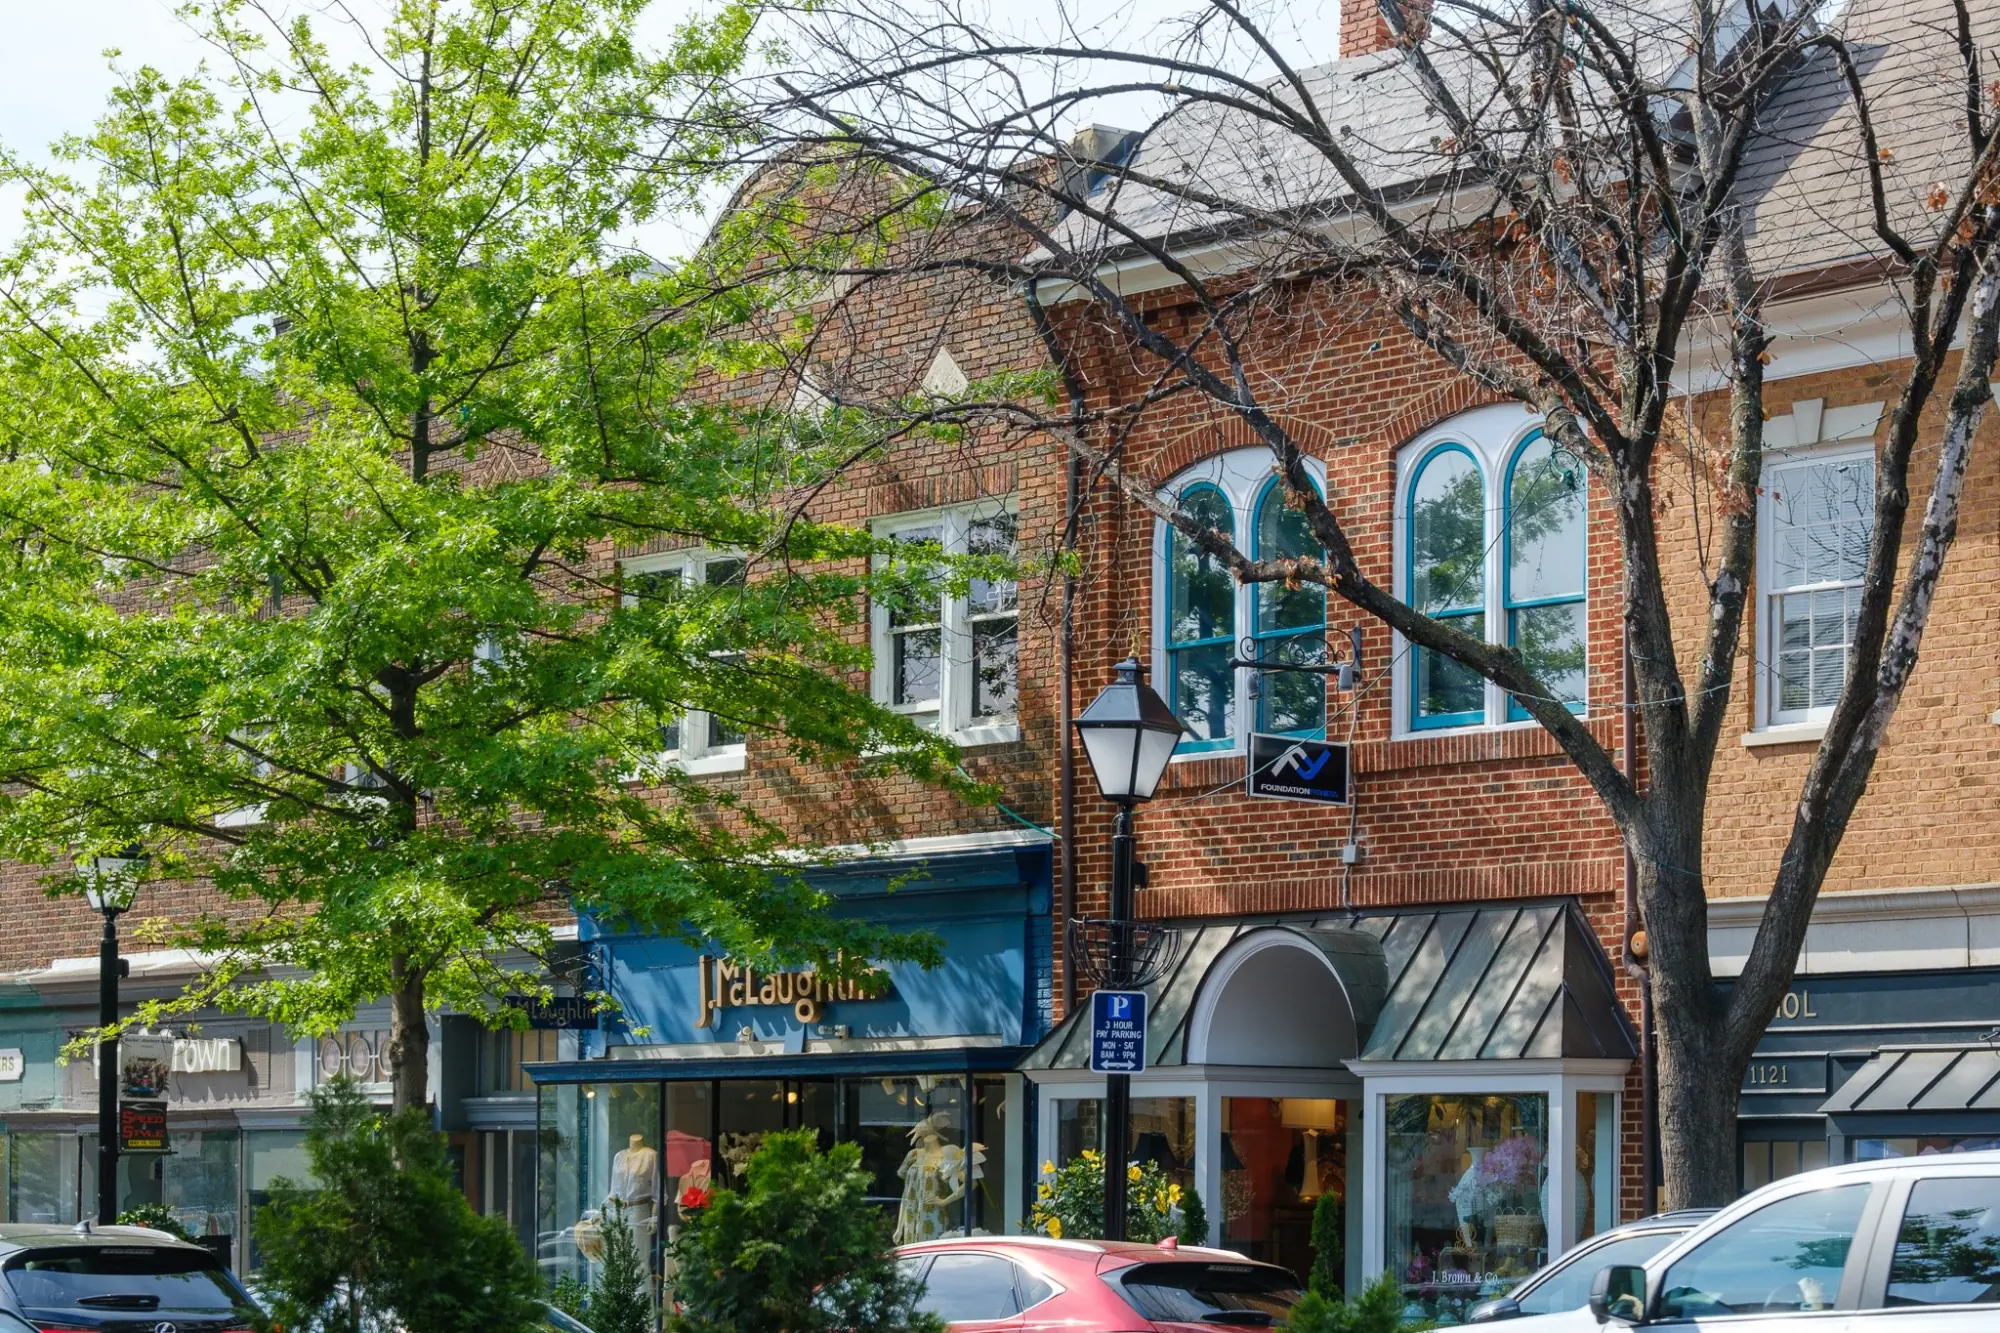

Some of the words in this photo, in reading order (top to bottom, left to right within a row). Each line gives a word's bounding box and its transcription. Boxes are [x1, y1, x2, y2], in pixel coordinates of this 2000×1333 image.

[1112, 996, 1129, 1017] P
[1776, 990, 1817, 1018] OL
[1105, 1021, 1111, 1029] 3
[1113, 1021, 1134, 1030] HOUR
[1096, 1030, 1109, 1039] PAY
[1111, 1030, 1142, 1039] PARKING
[1102, 1041, 1116, 1050] MON
[1123, 1041, 1135, 1050] SAT
[1100, 1050, 1115, 1059] 8AM
[1122, 1051, 1136, 1059] 9PM
[0, 1056, 15, 1072] RS
[1750, 1064, 1788, 1083] 1121
[1431, 1270, 1439, 1285] J.
[1441, 1270, 1471, 1283] Brown
[1474, 1271, 1482, 1284] &
